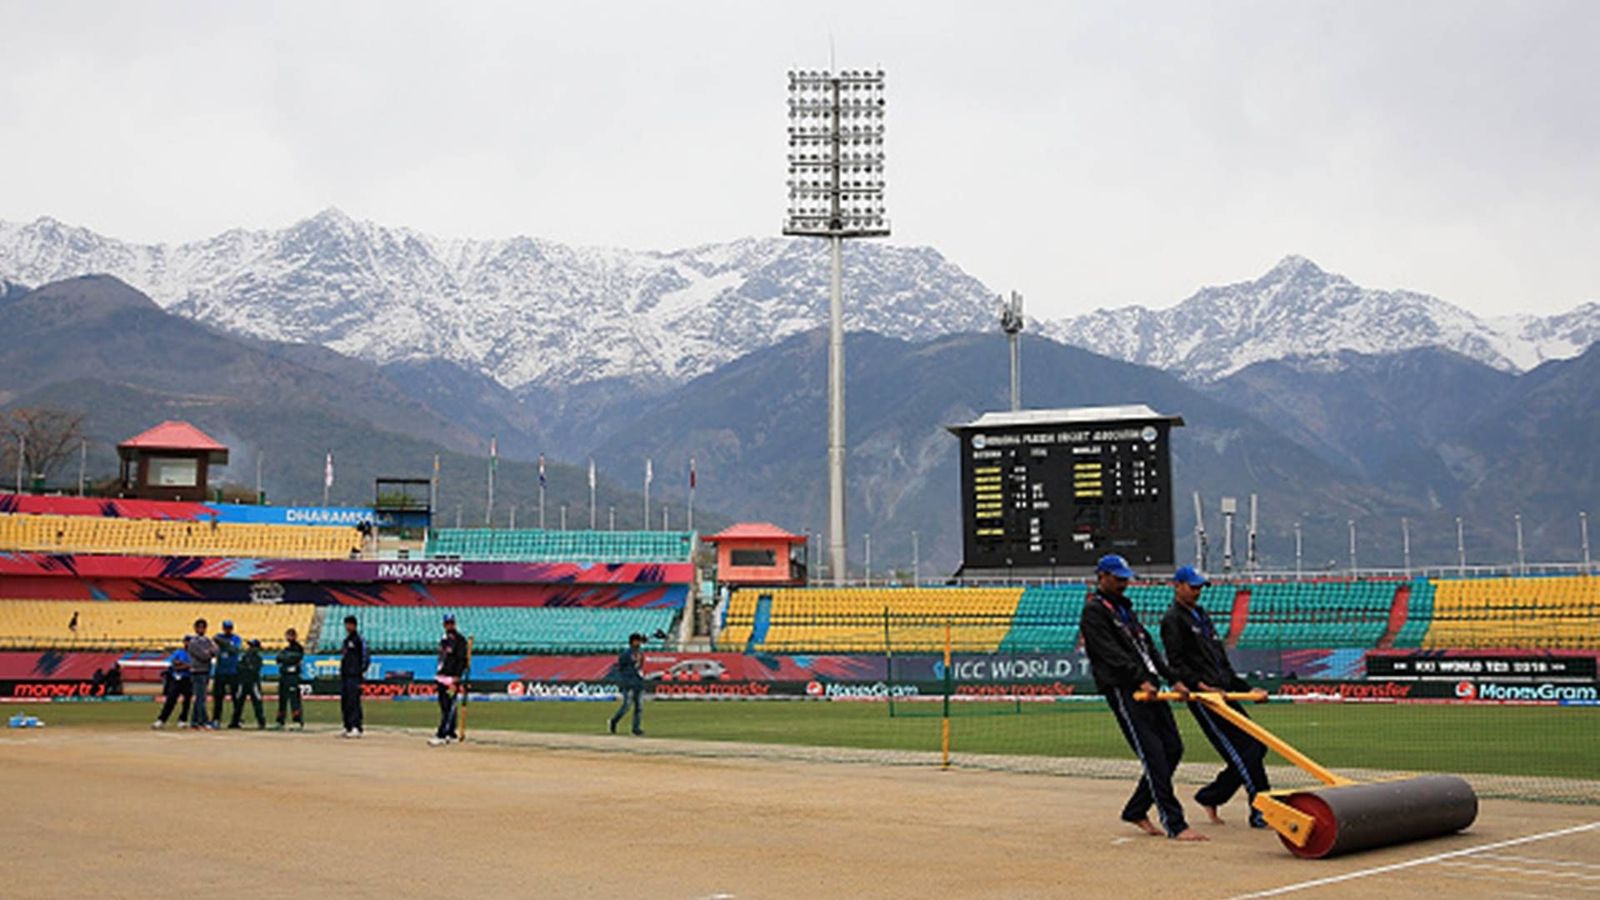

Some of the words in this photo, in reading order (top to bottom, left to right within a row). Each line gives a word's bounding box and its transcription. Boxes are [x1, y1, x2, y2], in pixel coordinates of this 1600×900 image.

[378, 562, 422, 578] INDIA
[954, 661, 985, 679] ICC
[991, 659, 1072, 678] WORLD
[14, 684, 77, 697] money
[527, 681, 619, 697] MoneyGram
[1338, 682, 1412, 697] transfer
[1479, 683, 1597, 699] MoneyGram
